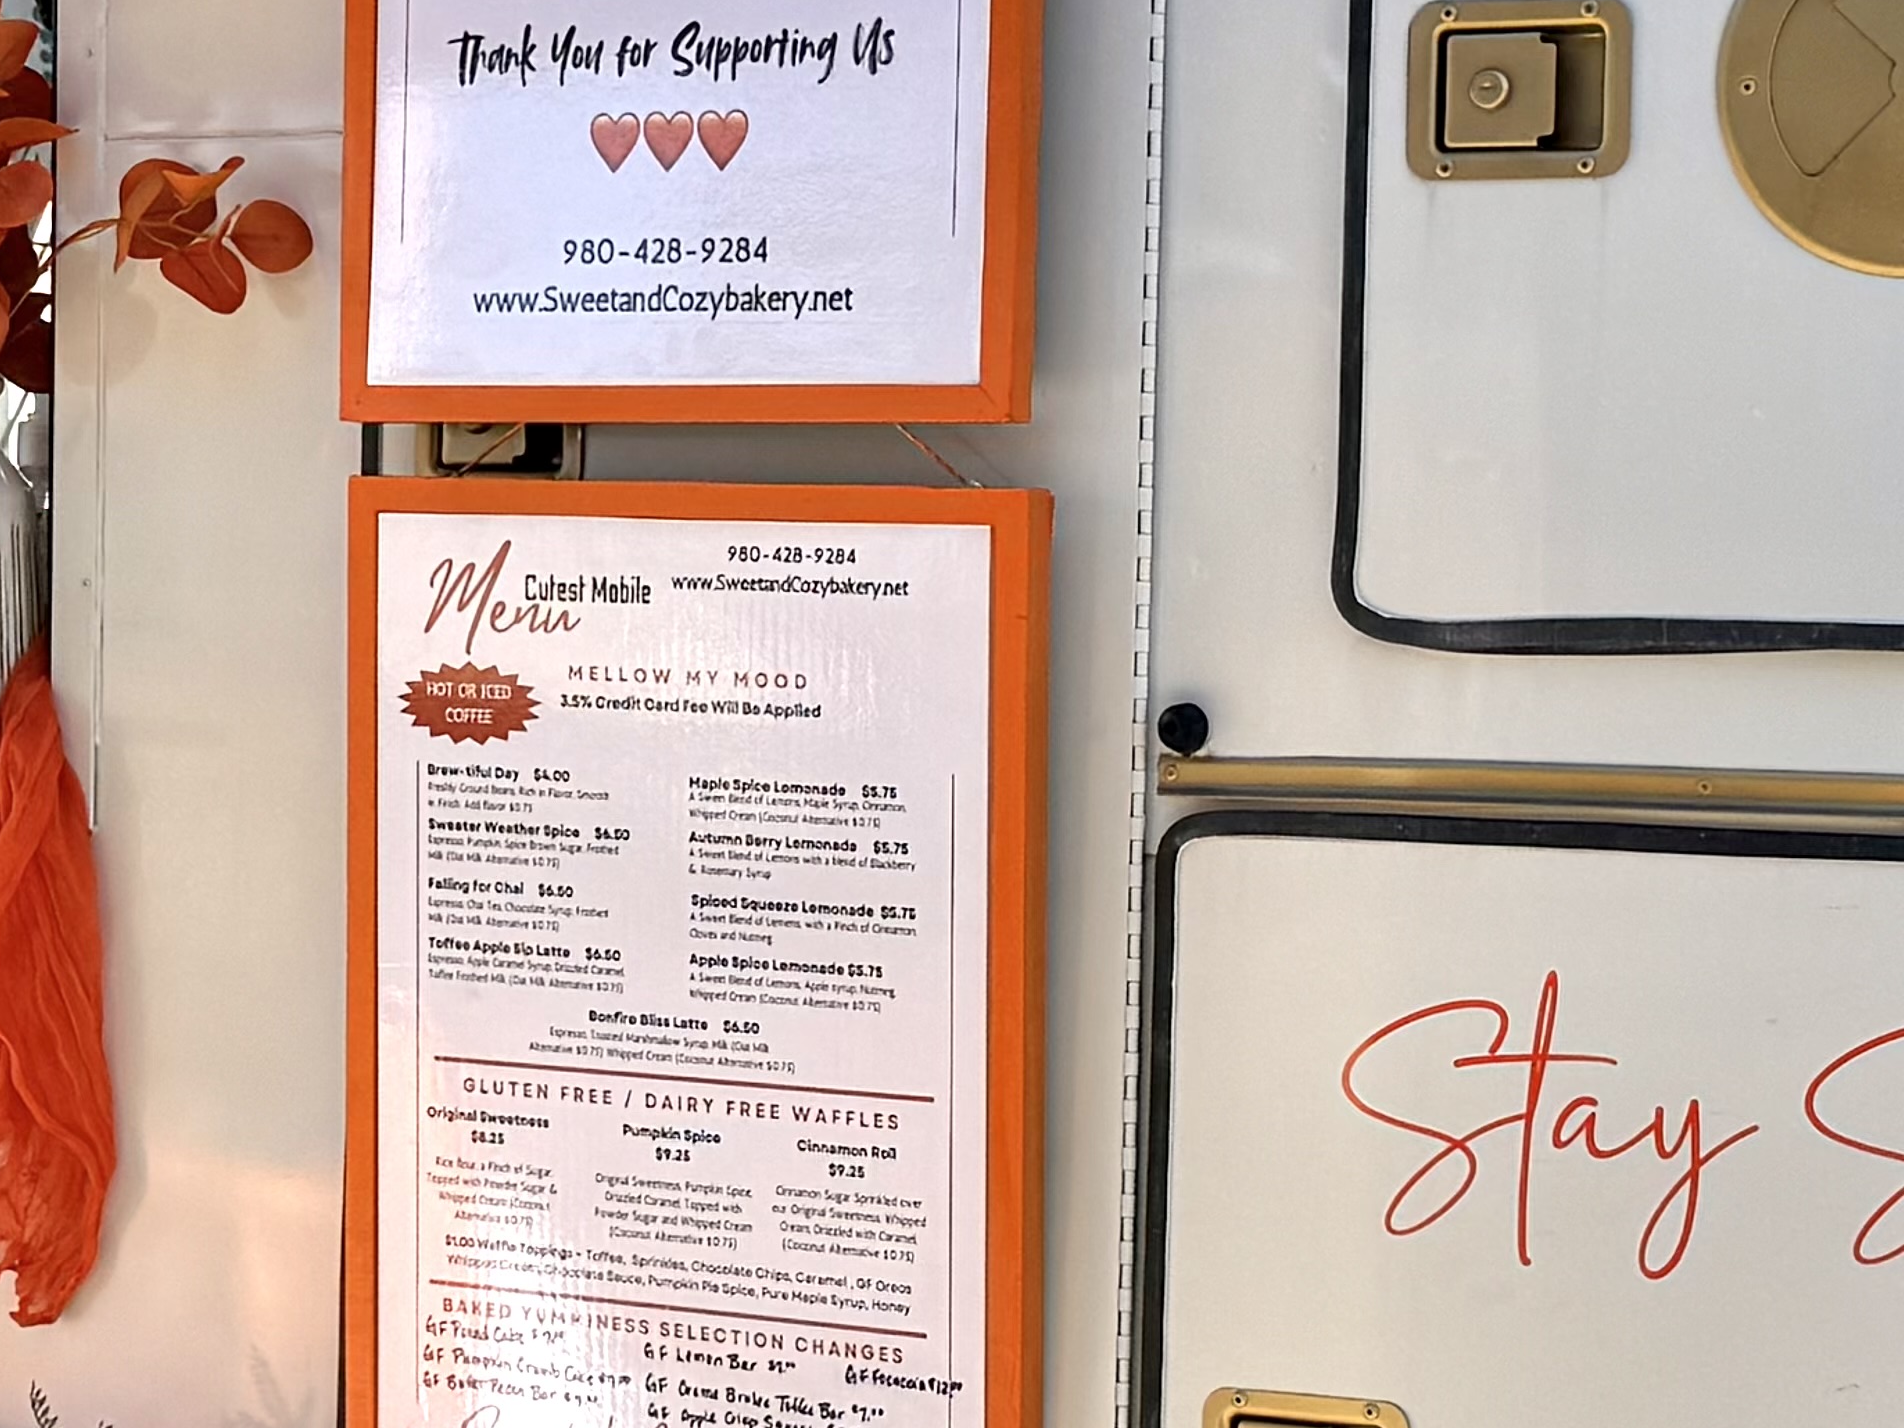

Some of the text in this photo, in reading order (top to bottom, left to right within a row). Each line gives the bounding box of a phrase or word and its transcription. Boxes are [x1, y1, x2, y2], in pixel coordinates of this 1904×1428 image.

[448, 17, 895, 87] Thank You for Supporting Us
[562, 238, 770, 265] 980-428-9284
[473, 284, 853, 321] www.SweetandCozybakery.net
[728, 546, 856, 564] 980-428-9284
[424, 540, 581, 655] Menu
[524, 574, 651, 604] Cutest Mobile
[569, 665, 807, 689] MELLOW MY MOOD
[426, 681, 512, 699] HOT OR ICED
[445, 707, 493, 724] COFFEE
[560, 694, 822, 719] 3.5% Credit Card Fee Will Be Applied
[495, 767, 519, 782] Day
[733, 779, 771, 794] Spice
[774, 781, 846, 797] Lemonade
[428, 818, 482, 833] Sweater
[484, 821, 541, 836] Weather
[544, 825, 581, 840] Spice
[688, 831, 743, 846] Autumn
[786, 836, 858, 852] Lemonade
[428, 877, 470, 894] Falling
[473, 879, 492, 893] for
[691, 894, 738, 910] Spiced
[801, 901, 874, 918] Lemonade
[428, 937, 470, 951] Toffee
[473, 940, 511, 955] Apple
[536, 945, 571, 958] Latte
[690, 954, 729, 968] Apple
[732, 956, 770, 971] Spice
[773, 959, 845, 976] Lemonade
[589, 1010, 637, 1026] Bonfire
[673, 1016, 708, 1031] Latte
[463, 1077, 899, 1130] GLUTEN FREE / DAIRY FREE WAFFLES
[427, 1106, 549, 1128] Original Sweetness
[1341, 970, 1760, 1279] Stay
[623, 1124, 721, 1145] Pumpkin Spice
[797, 1139, 896, 1160] Cinnamon Roll
[443, 1298, 511, 1319] BAKED
[660, 1321, 784, 1350] SELECTION
[796, 1336, 903, 1364] CHANGES
